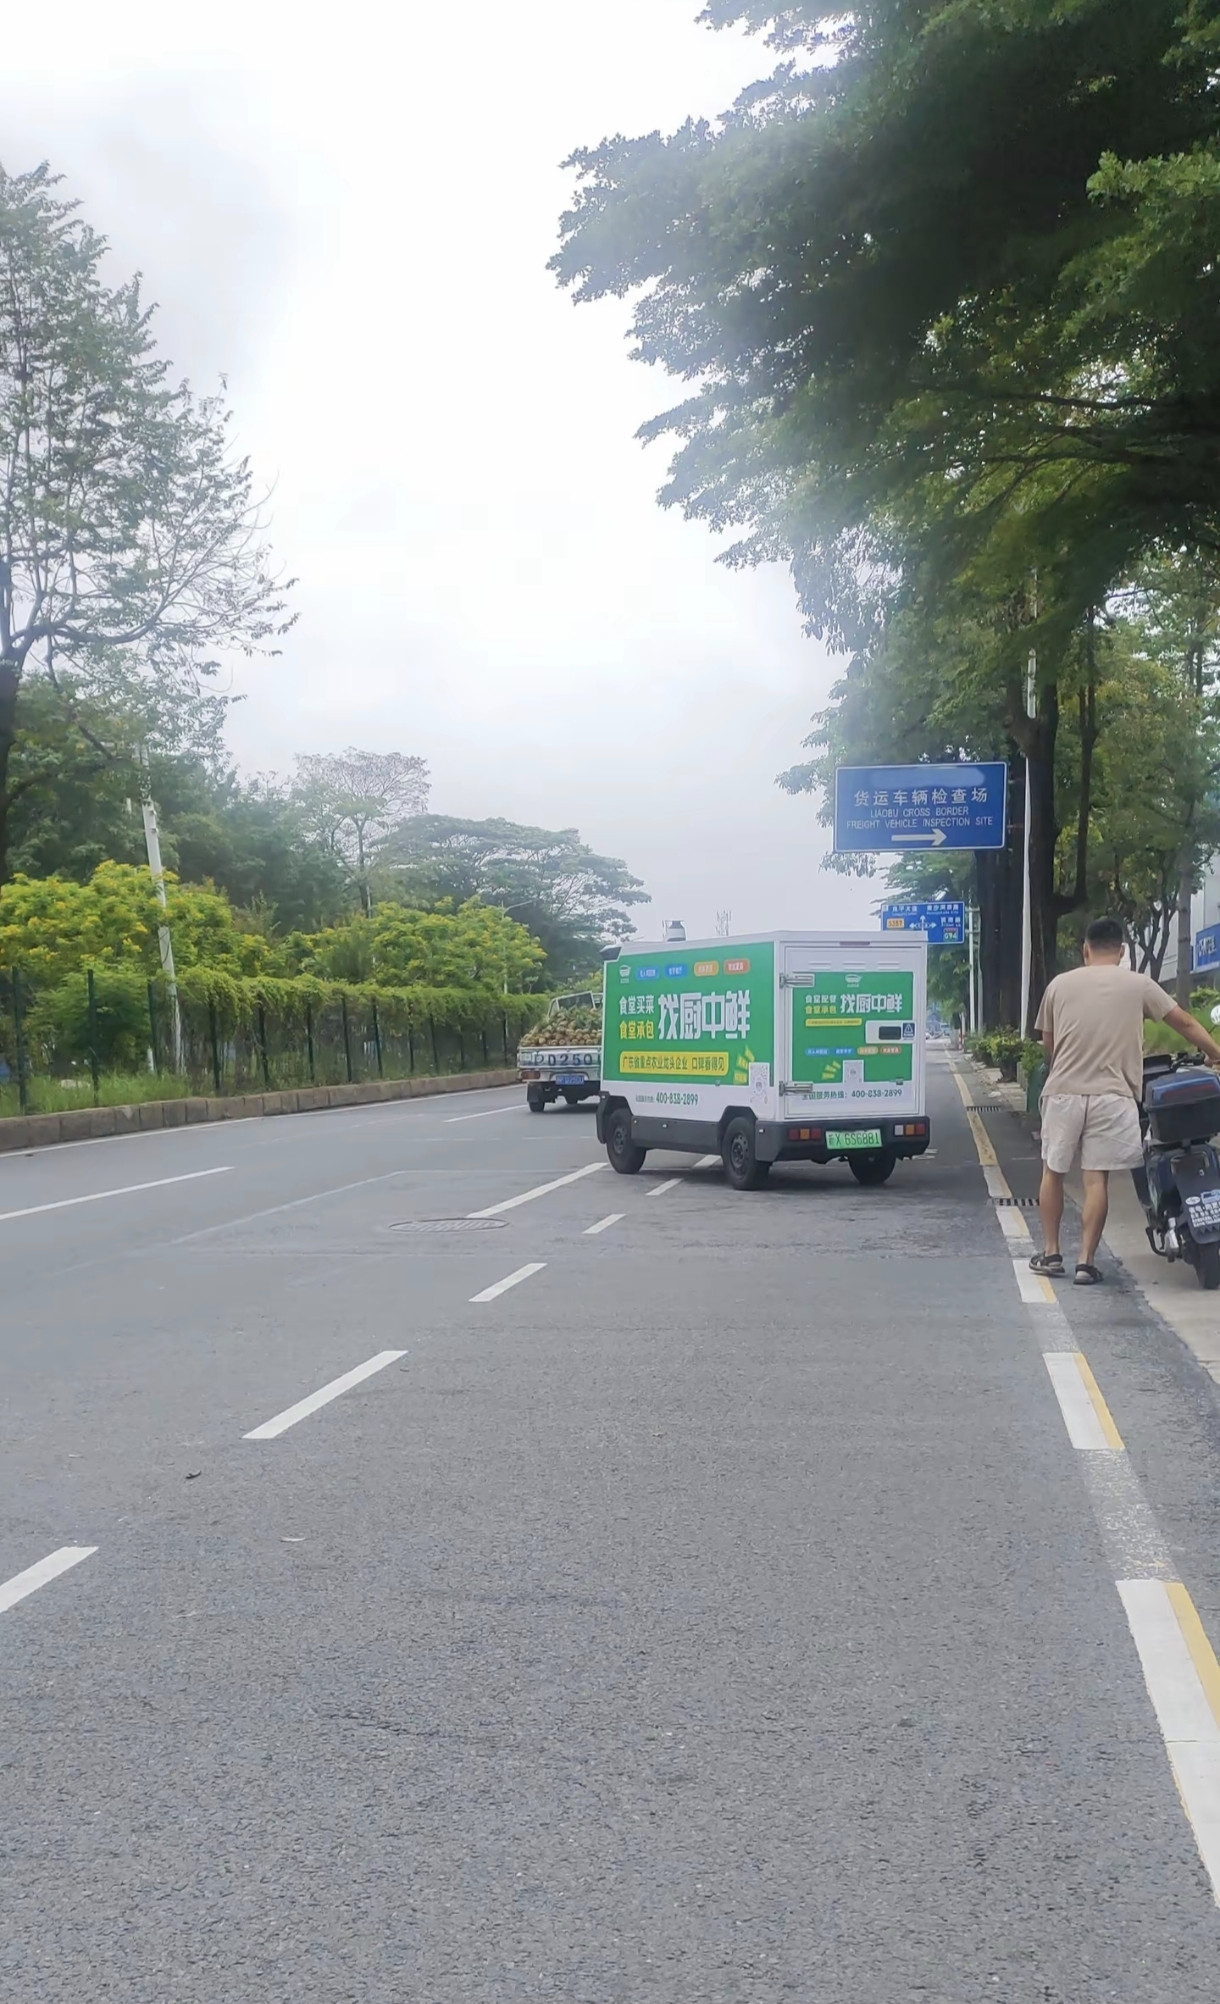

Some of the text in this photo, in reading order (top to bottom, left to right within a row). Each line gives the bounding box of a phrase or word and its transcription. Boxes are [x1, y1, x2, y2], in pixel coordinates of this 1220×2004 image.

[854, 787, 988, 807] 货运车辆检查场
[870, 806, 969, 818] LIAOBU CROSS BORDER
[847, 816, 993, 829] FREIGHT VEHICLE INSPECTION SITE
[619, 995, 655, 1015] 食堂买菜
[840, 993, 903, 1014] 找厨中鲜
[658, 989, 751, 1040] 找厨中鲜
[619, 1020, 655, 1040] 食堂承包
[656, 1092, 699, 1105] 400-838-2899
[852, 1089, 902, 1098] 400-838-2899
